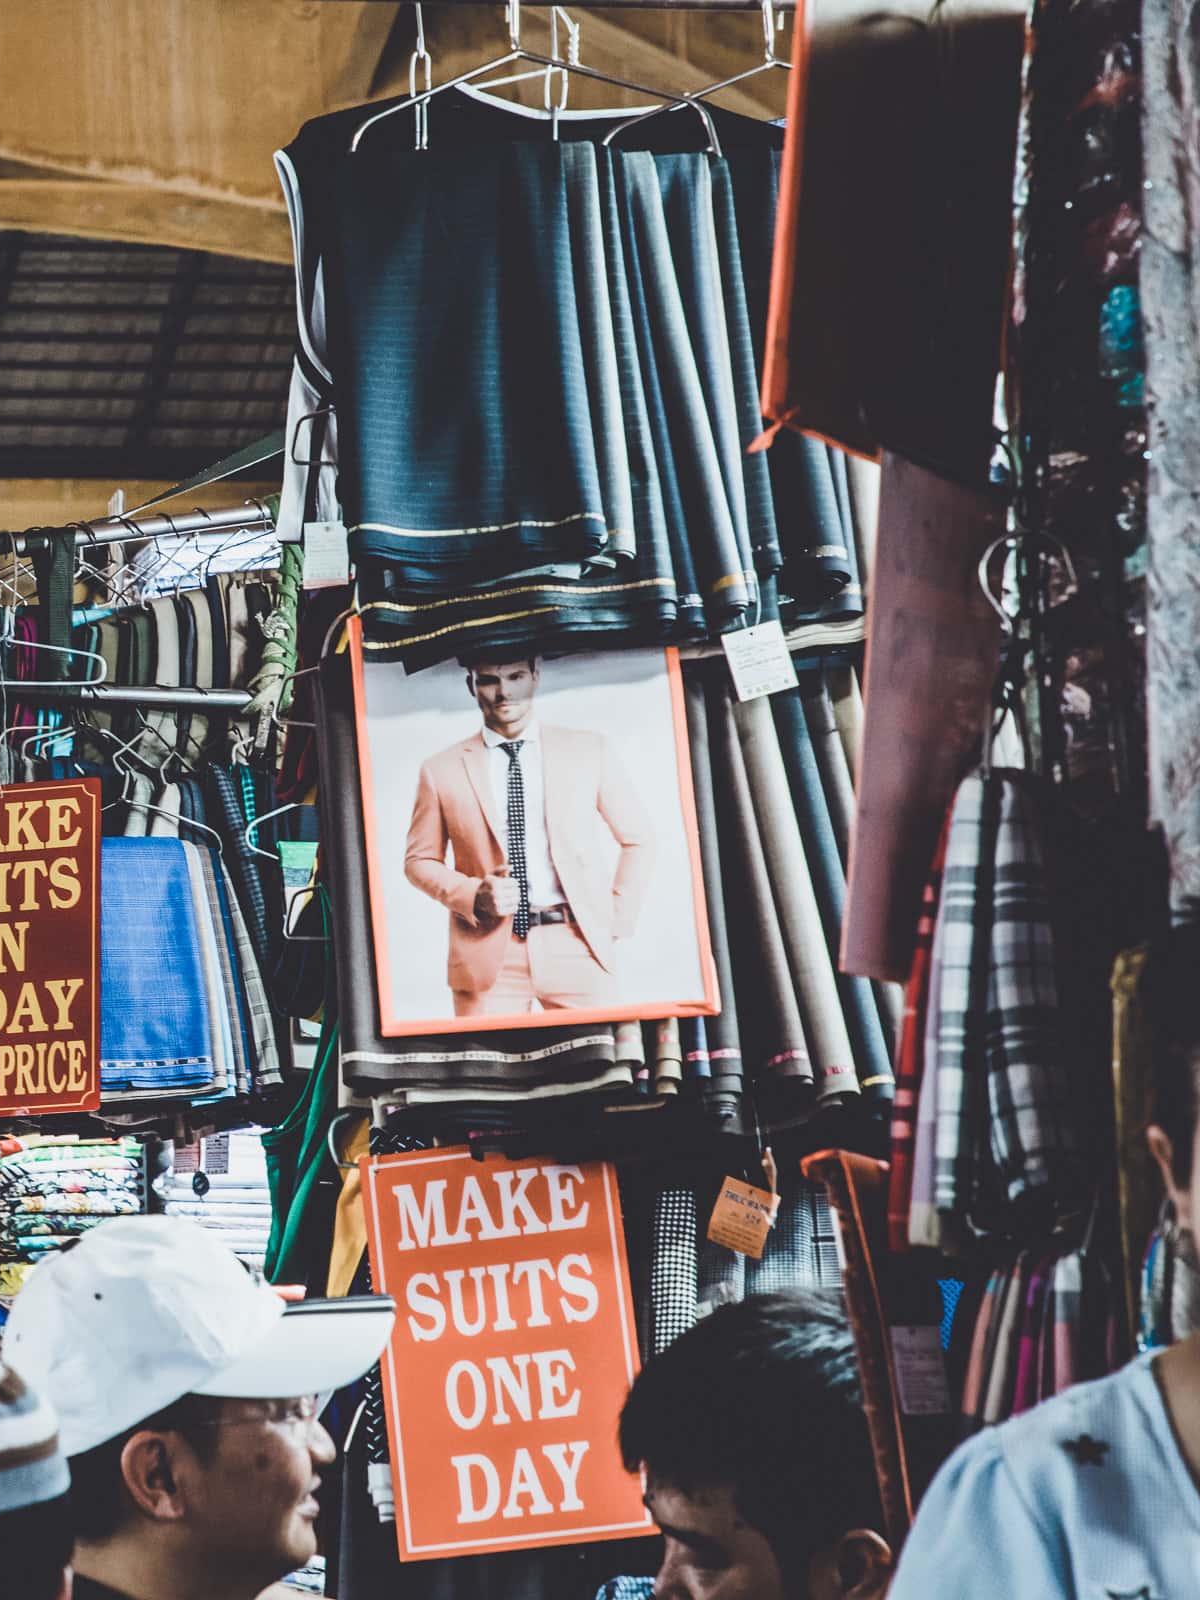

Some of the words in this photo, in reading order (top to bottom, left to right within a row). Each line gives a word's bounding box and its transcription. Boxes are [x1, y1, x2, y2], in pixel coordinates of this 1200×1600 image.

[392, 1163, 590, 1252] MAKE
[405, 1253, 599, 1342] SUITS
[445, 1349, 581, 1431] ONE
[450, 1441, 589, 1525] DAY
